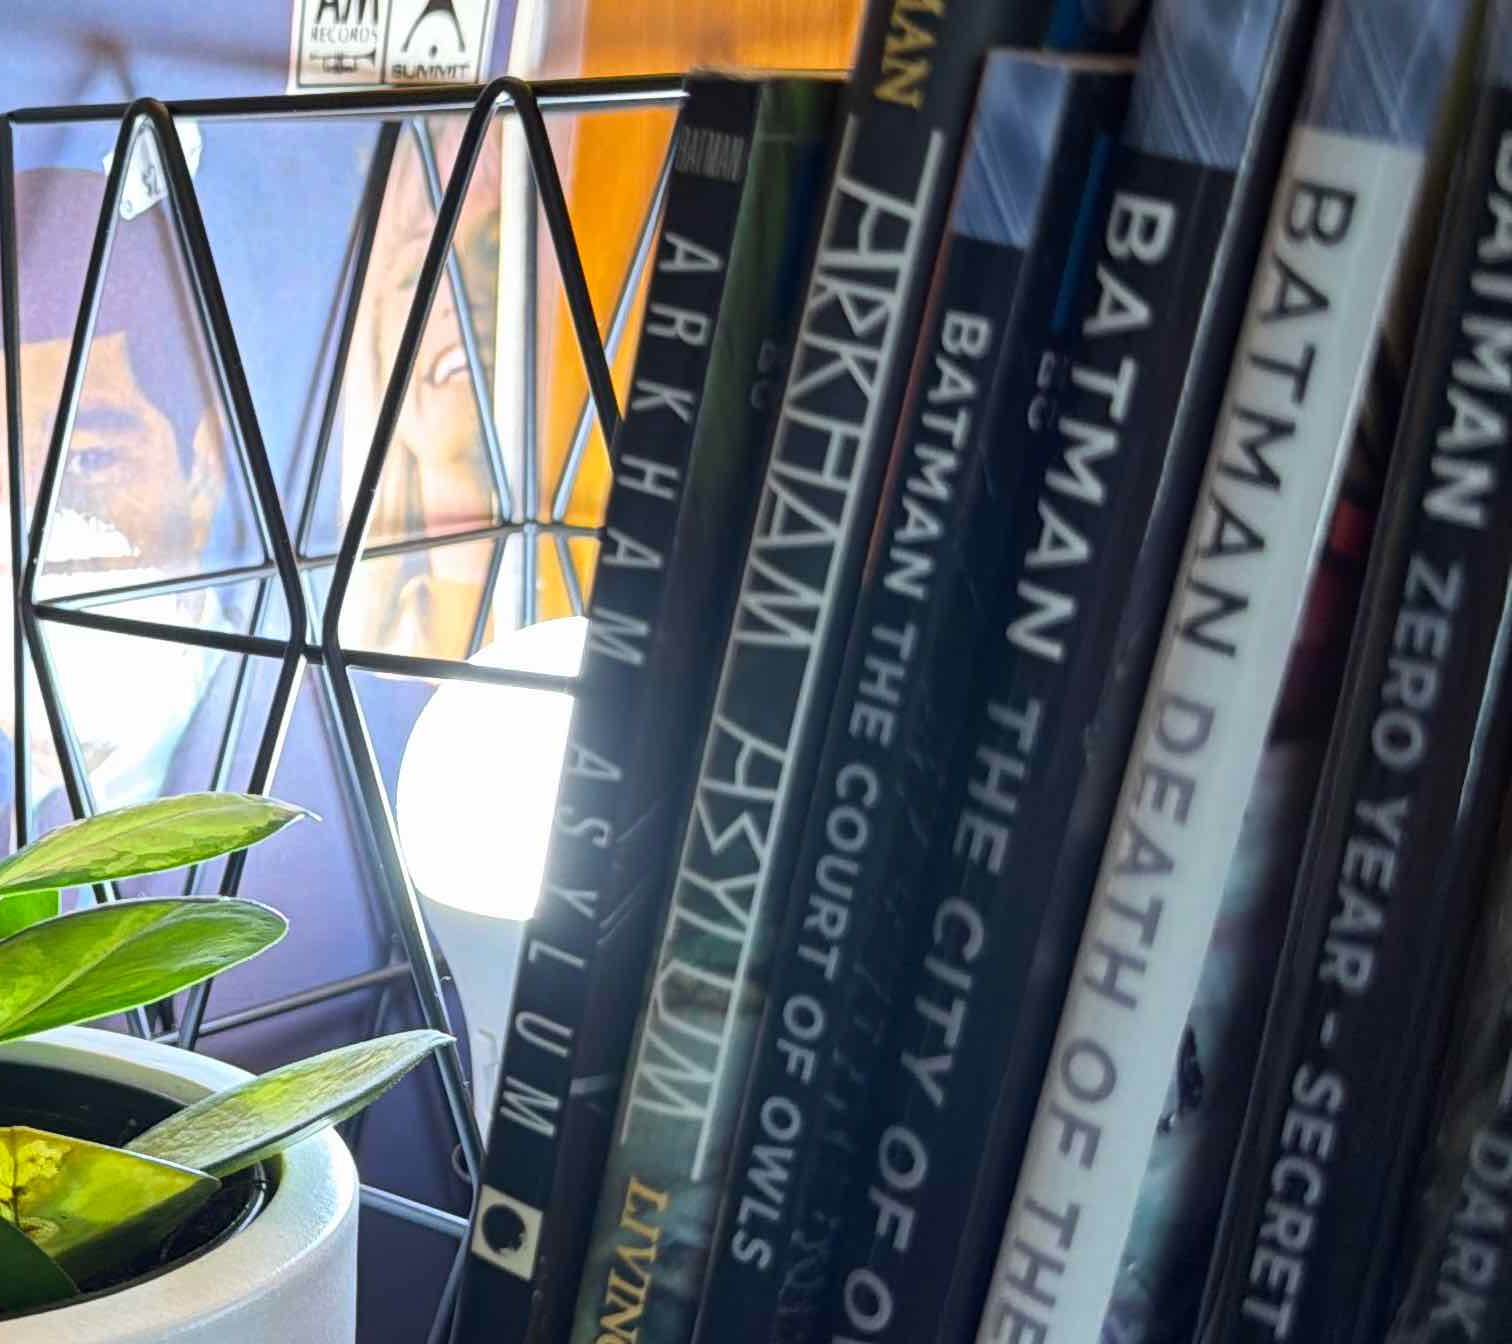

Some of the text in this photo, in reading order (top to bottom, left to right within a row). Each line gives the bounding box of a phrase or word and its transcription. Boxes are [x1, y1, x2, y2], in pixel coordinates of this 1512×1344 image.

[391, 62, 470, 80] SUMMIT
[1004, 191, 1177, 661] BATMAN
[1178, 175, 1358, 661] BATMAN
[500, 230, 725, 1140] ARKHAM ASYLUM
[624, 136, 933, 1146] ARKHAM ASYLUM
[1370, 556, 1466, 773] ZERO
[730, 309, 994, 1271] BATMAN THE COURT OF OWLS
[952, 696, 1044, 876] THE
[1081, 690, 1217, 1012] DEATH
[1318, 793, 1410, 995] YEAR
[901, 897, 986, 1108] CITY
[1045, 1036, 1119, 1172] OF
[868, 1125, 929, 1253] OF
[1240, 1061, 1346, 1342] SECRET
[1428, 1128, 1512, 1342] DARK
